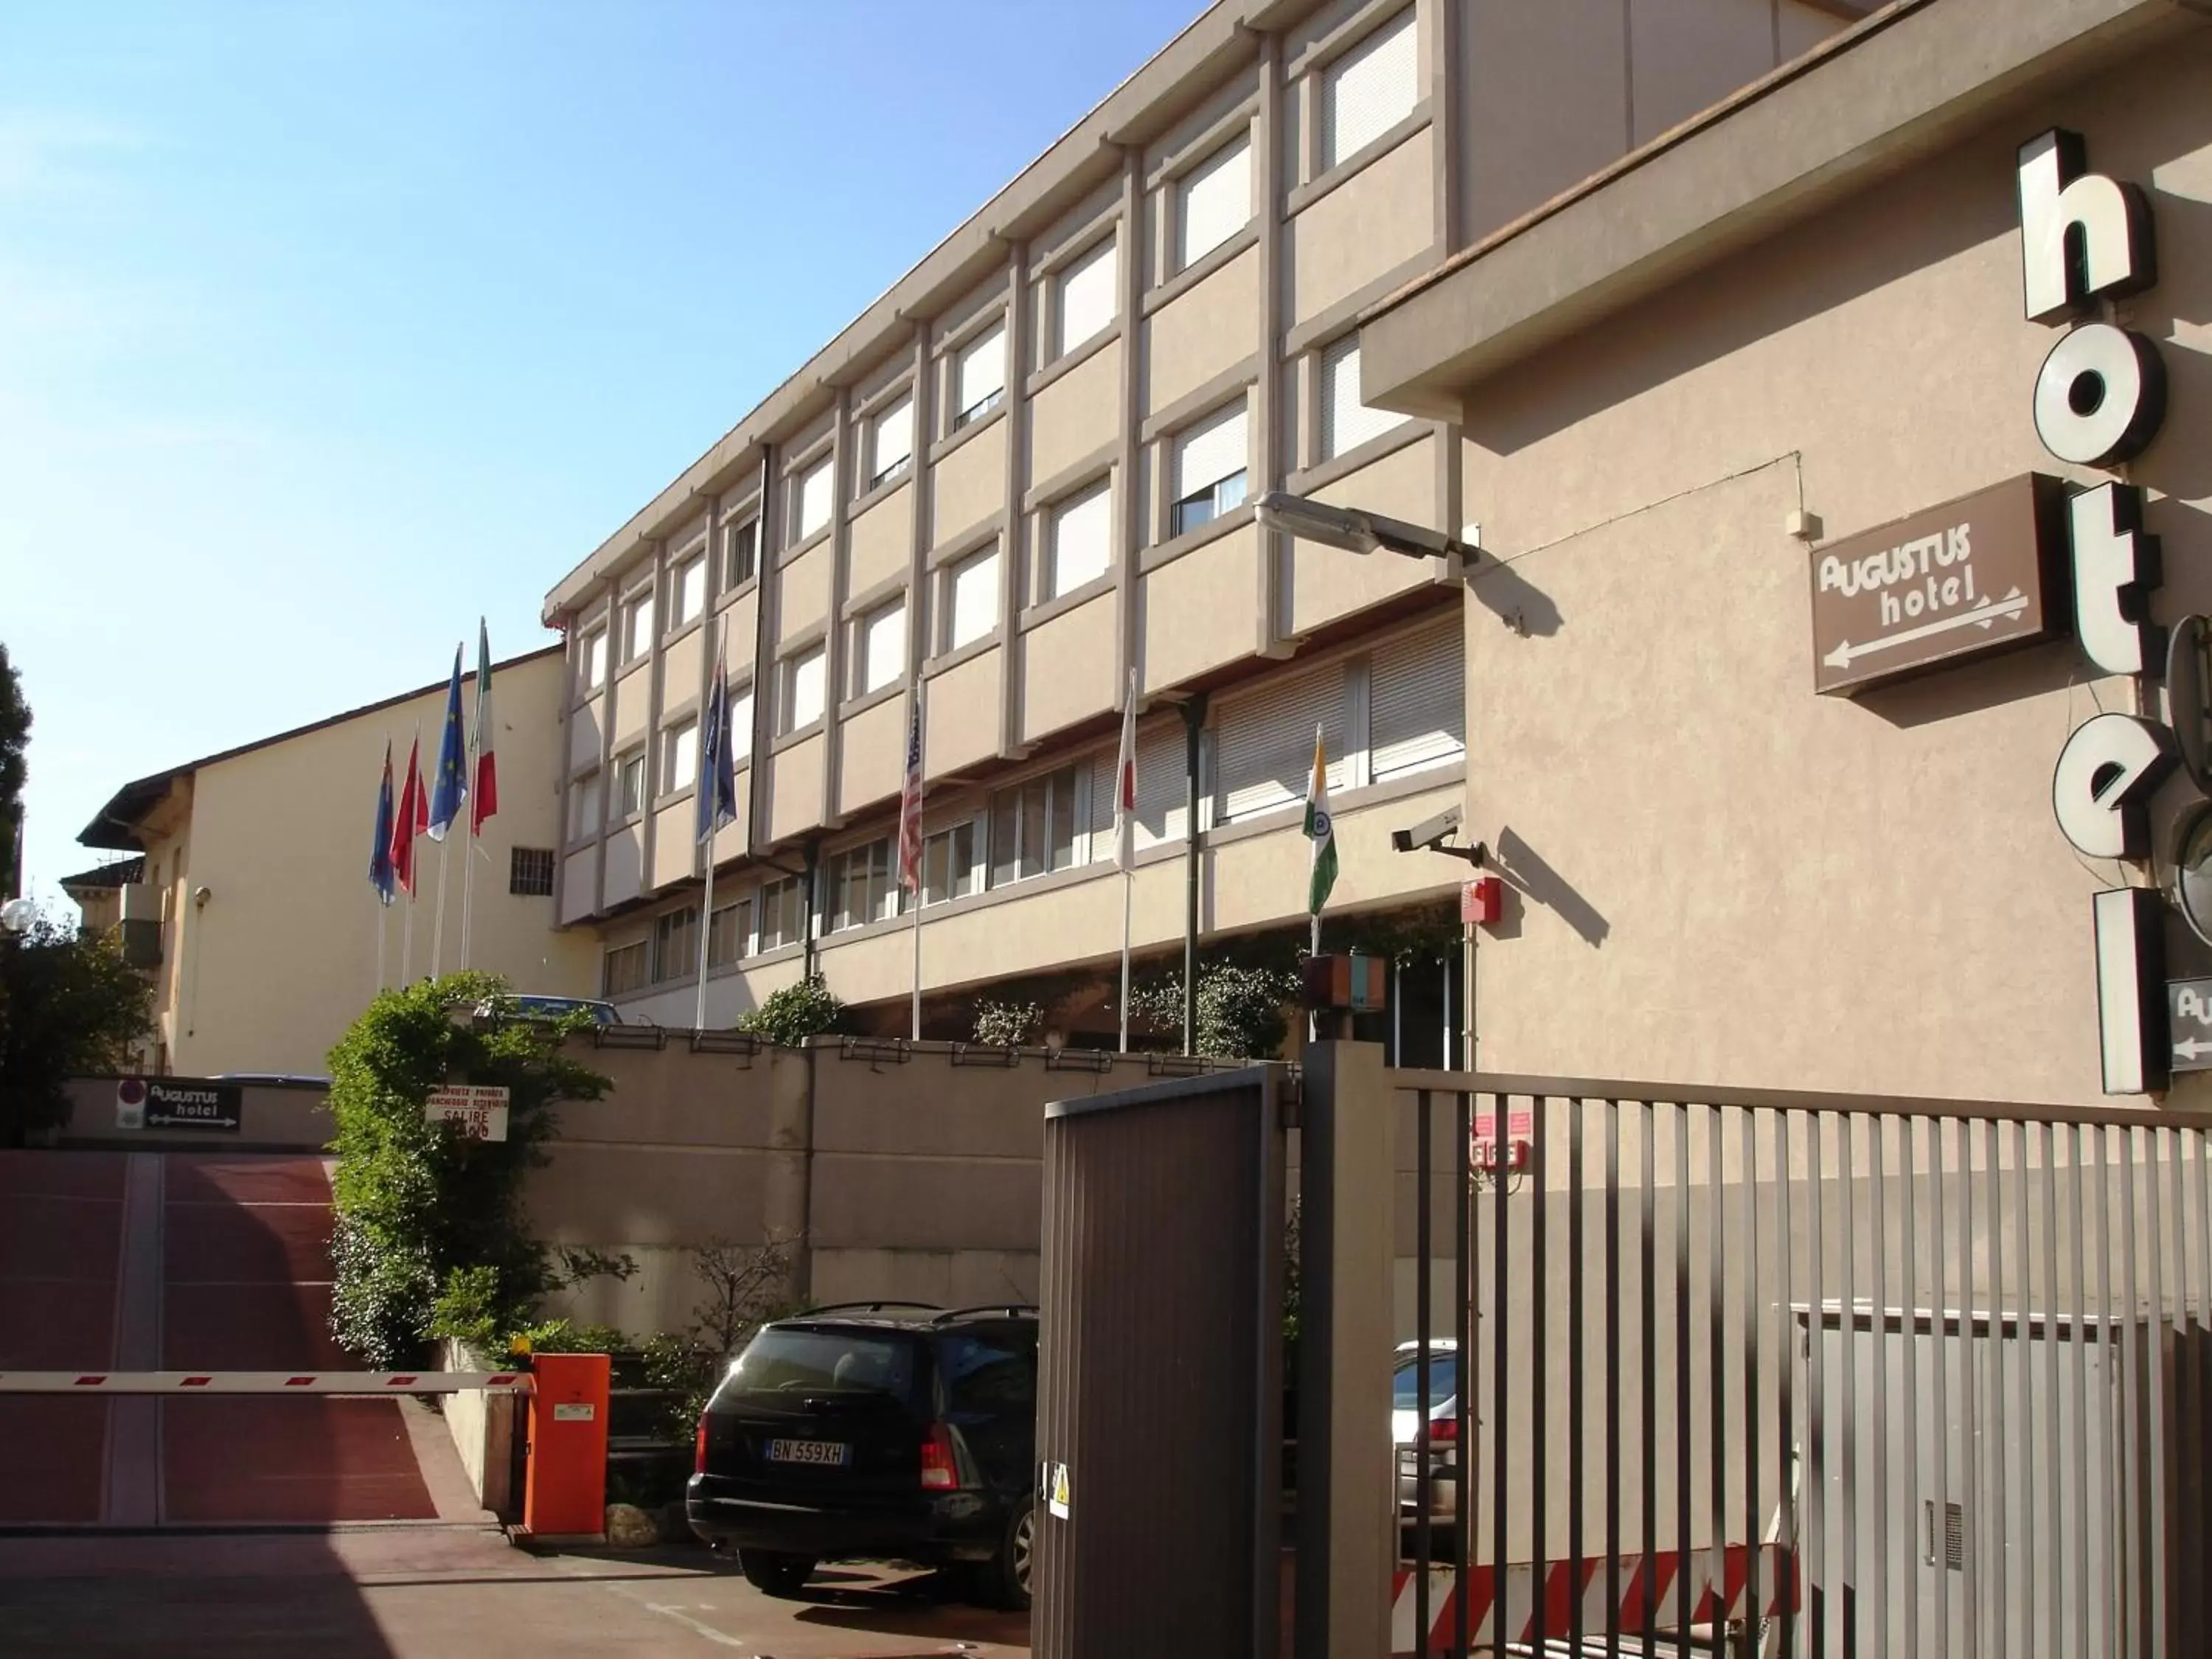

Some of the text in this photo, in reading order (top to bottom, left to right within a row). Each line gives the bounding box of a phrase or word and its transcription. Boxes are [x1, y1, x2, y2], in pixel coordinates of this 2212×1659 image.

[1820, 523, 1971, 597] AUGUSTUS
[1882, 565, 1974, 625] hotel
[2018, 127, 2162, 1094] hotel
[150, 1085, 218, 1103] AUGUSTUS
[176, 1104, 218, 1116] hotel
[445, 1110, 488, 1122] SALIRE
[773, 1441, 791, 1459] BN
